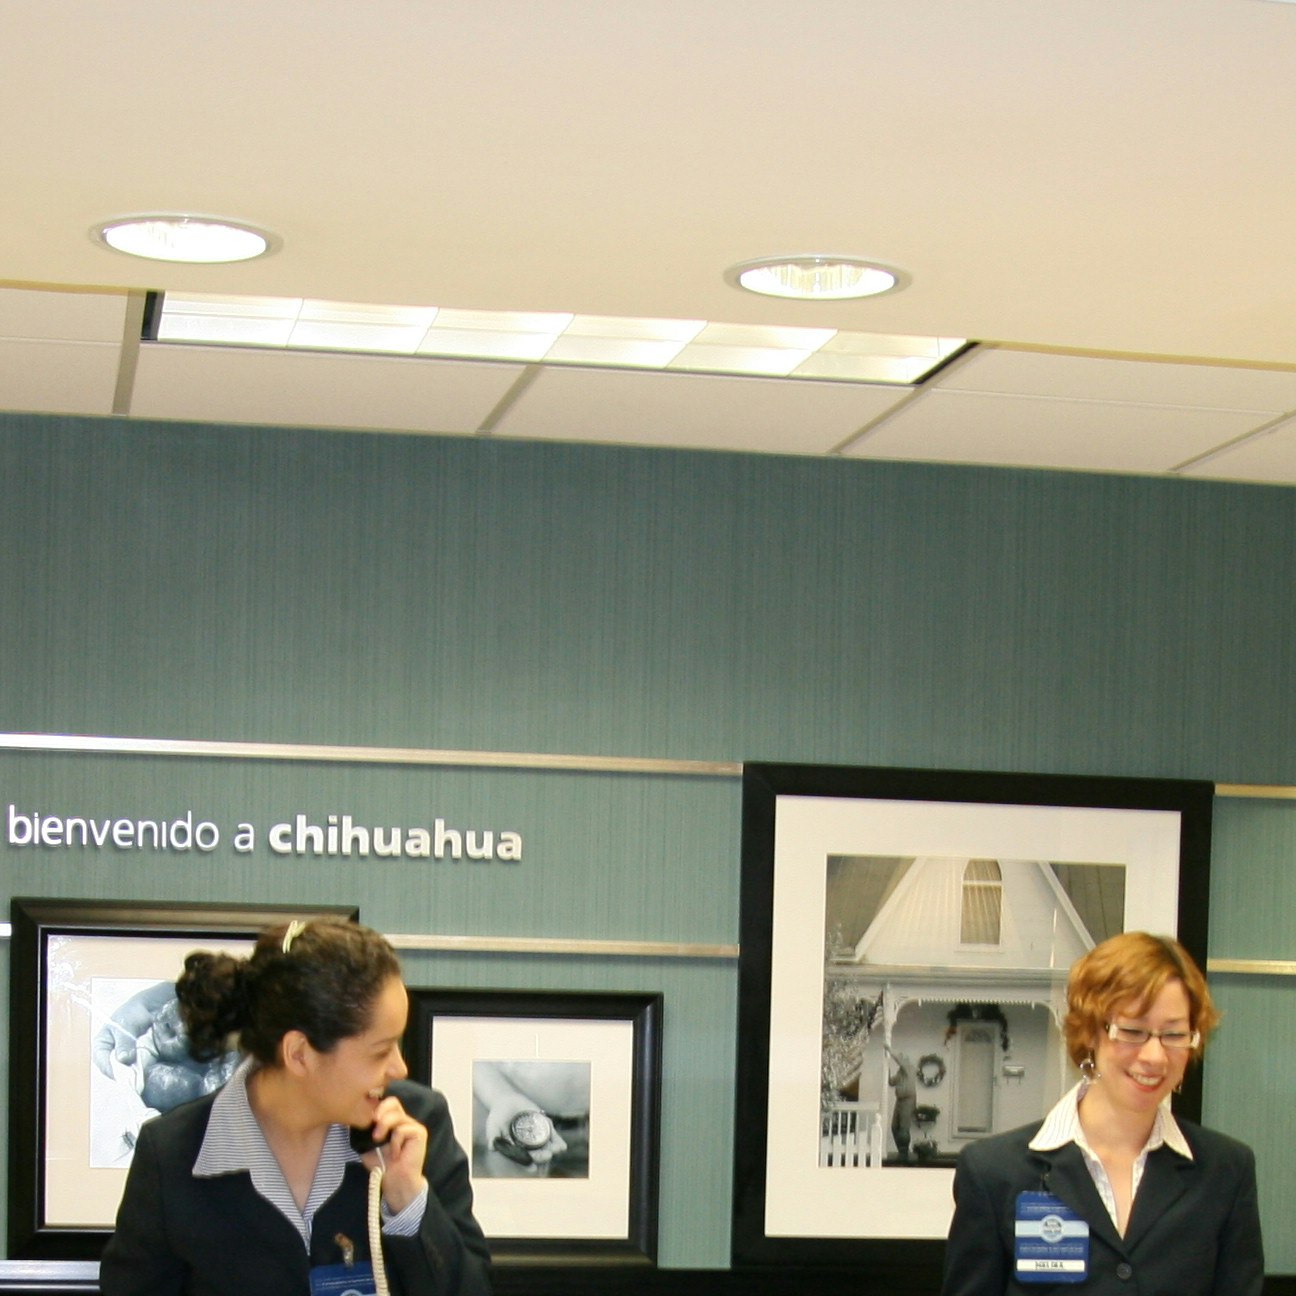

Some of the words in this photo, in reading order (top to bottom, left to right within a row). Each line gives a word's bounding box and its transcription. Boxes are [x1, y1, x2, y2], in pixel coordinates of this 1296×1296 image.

[8, 804, 220, 852] bienvenido
[234, 822, 256, 853] a
[269, 815, 523, 860] chihuahua
